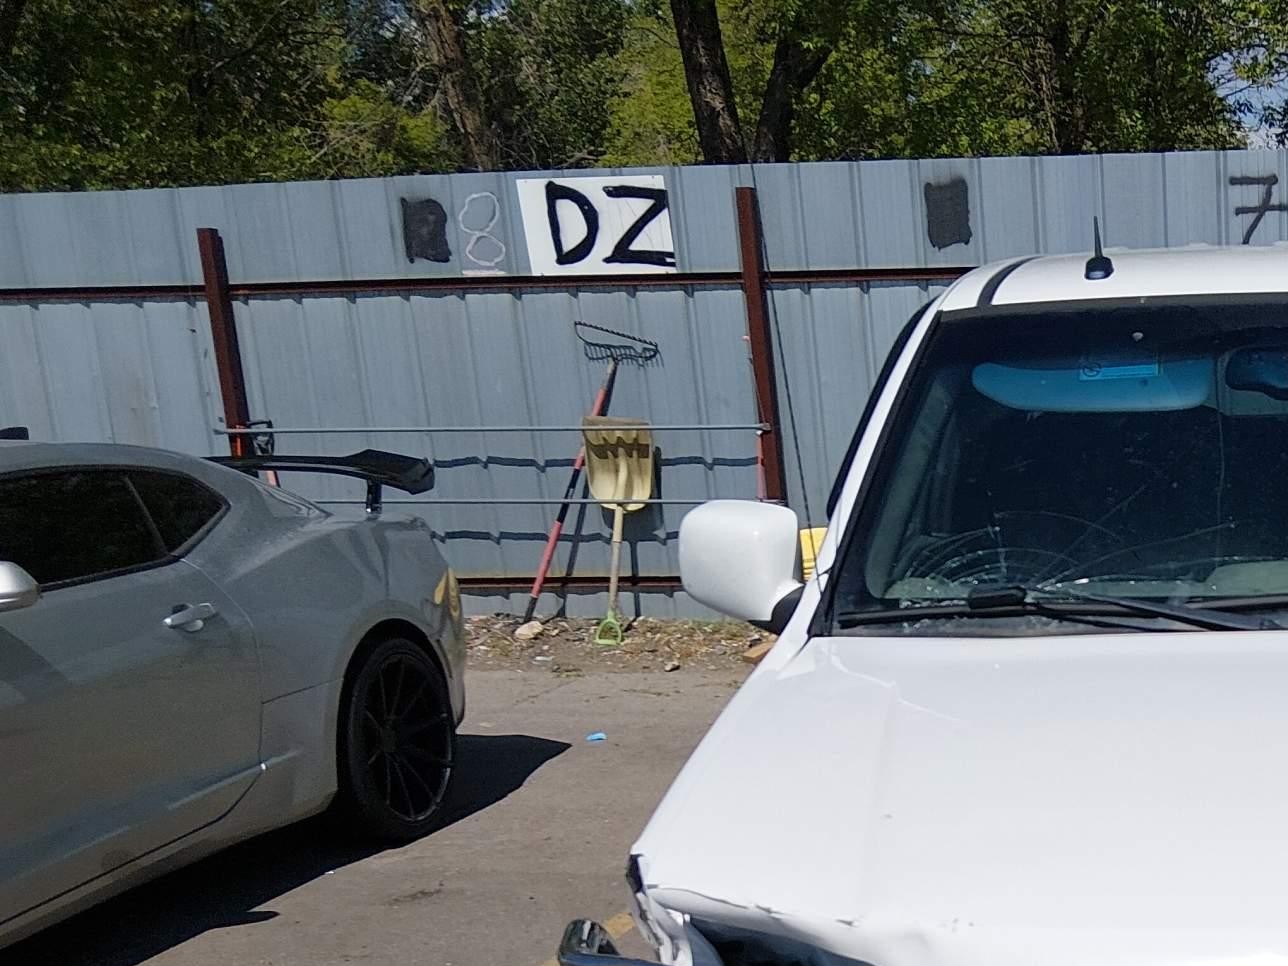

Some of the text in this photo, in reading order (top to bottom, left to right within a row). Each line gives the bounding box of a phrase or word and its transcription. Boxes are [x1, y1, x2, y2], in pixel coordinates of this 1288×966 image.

[459, 191, 506, 266] 8
[545, 180, 676, 267] DZ
[1228, 173, 1288, 244] 7
